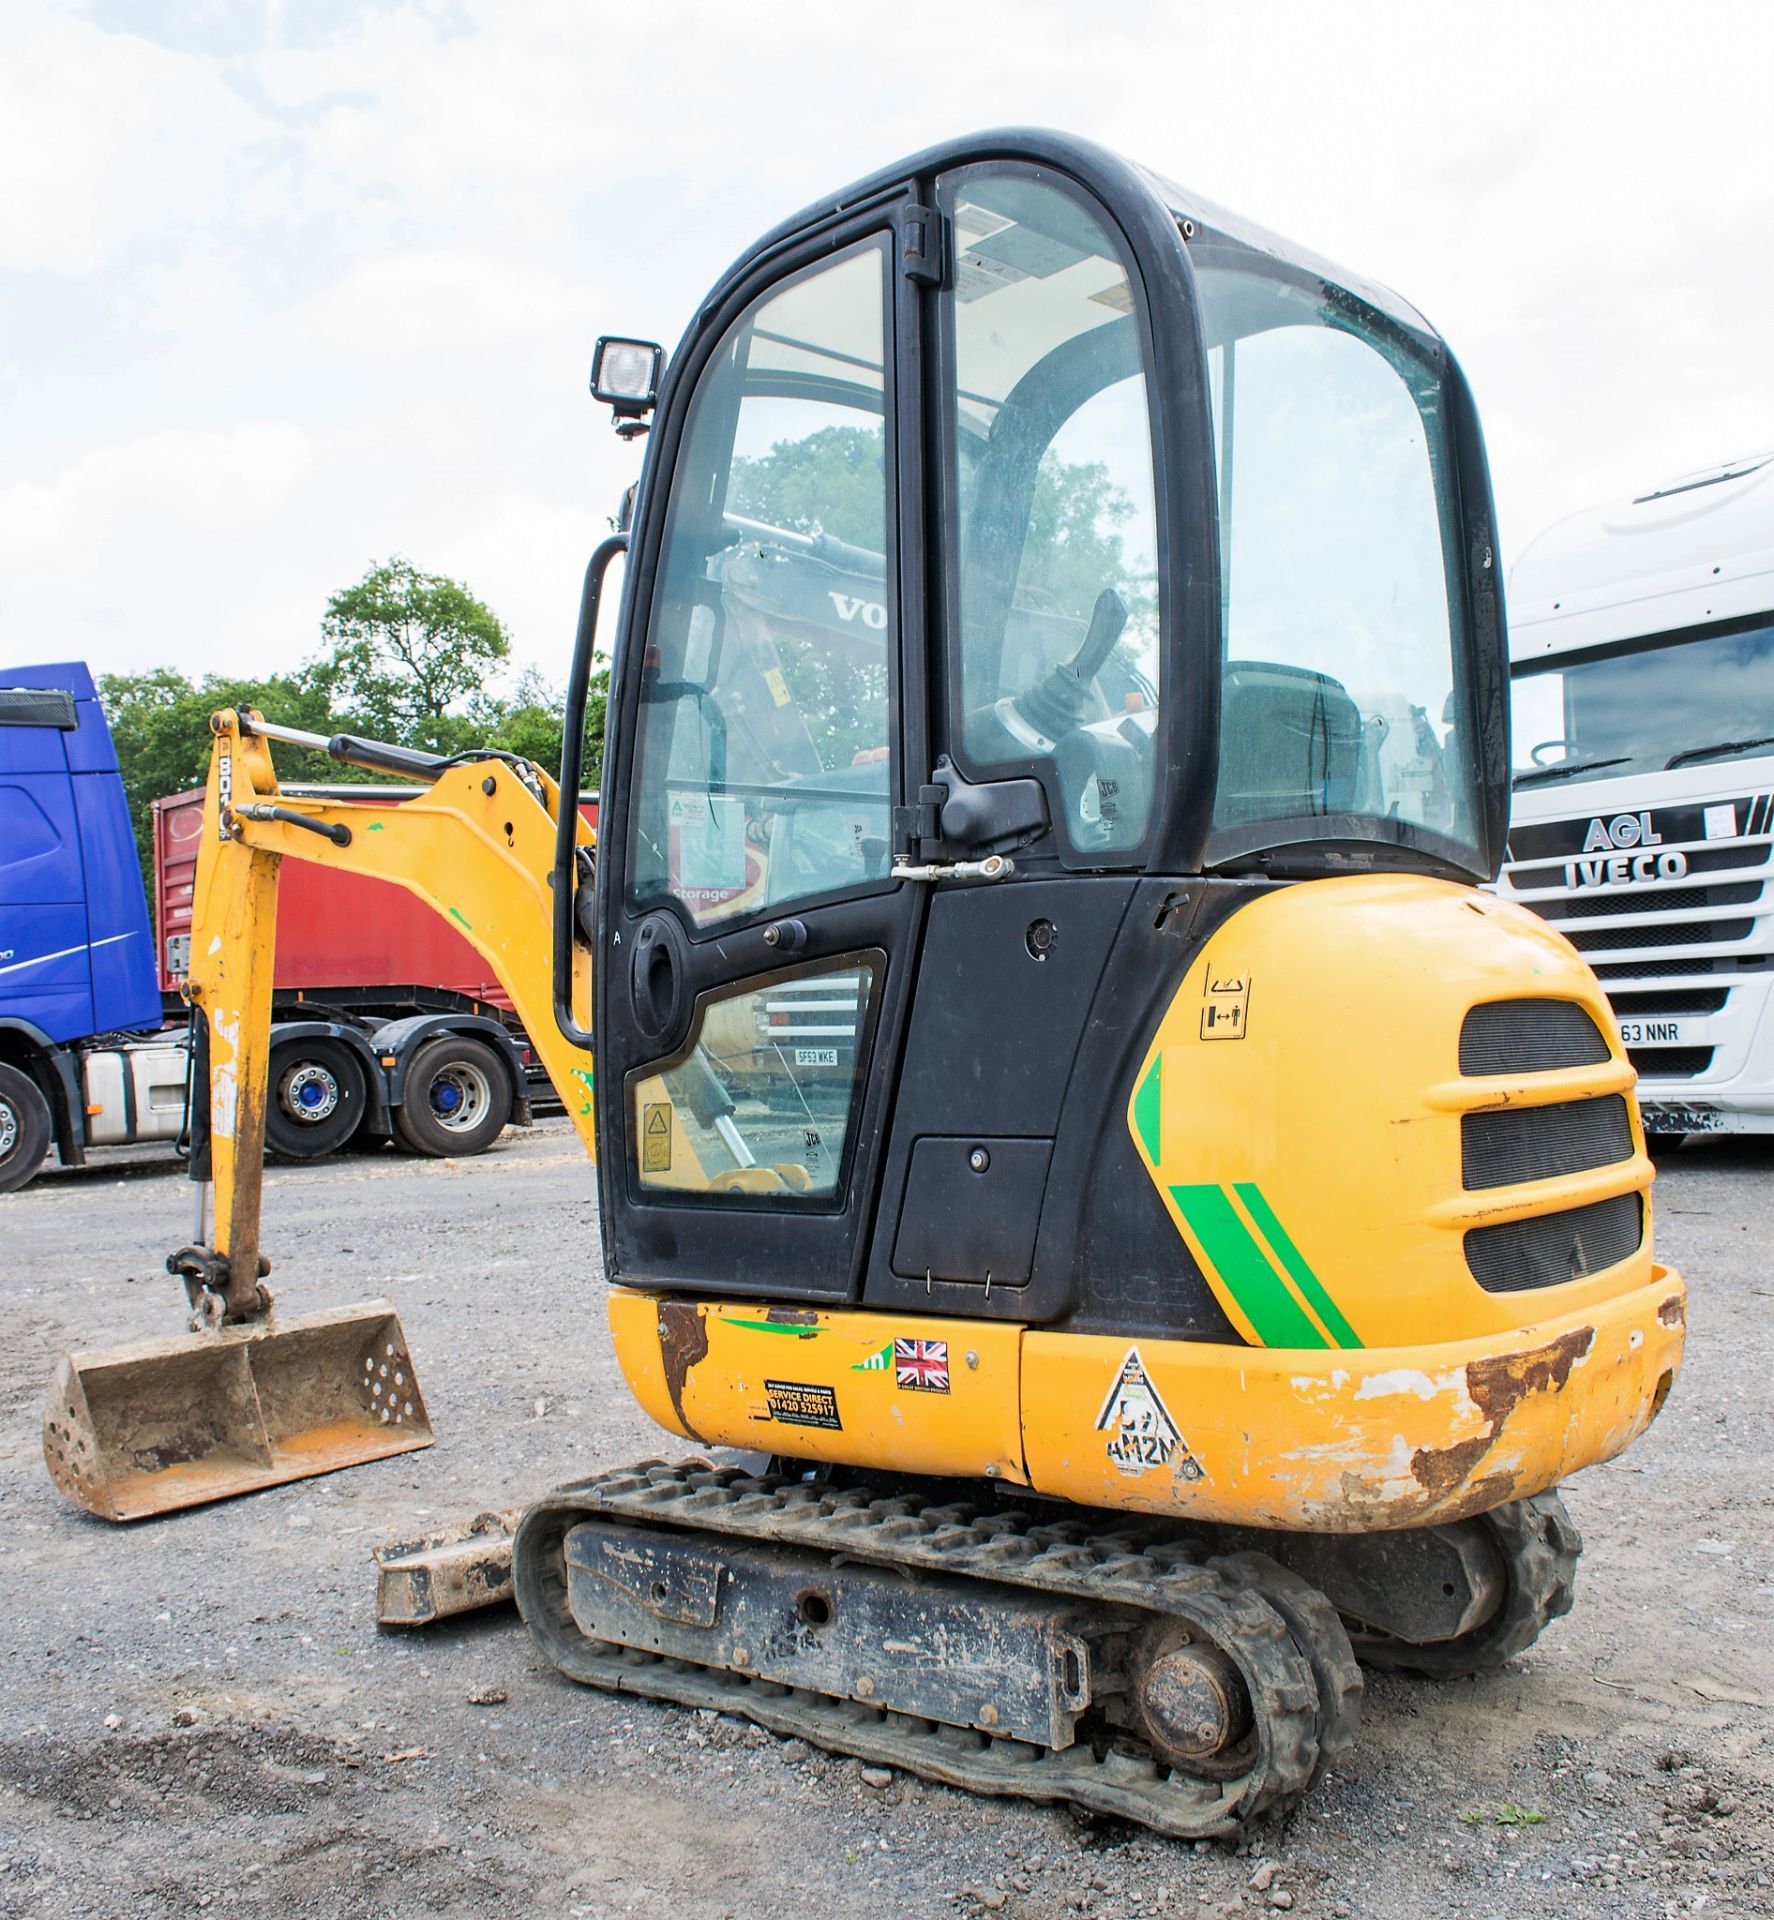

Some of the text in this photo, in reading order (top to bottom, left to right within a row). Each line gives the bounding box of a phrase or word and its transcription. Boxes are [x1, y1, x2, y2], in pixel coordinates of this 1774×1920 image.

[1583, 811, 1663, 852] AGL
[1565, 851, 1689, 890] IVECO
[673, 889, 729, 902] Storage
[1621, 1023, 1679, 1041] 63 NNR
[768, 1389, 833, 1405] SERVICE DIRECT
[770, 1398, 834, 1416] 01420 525917
